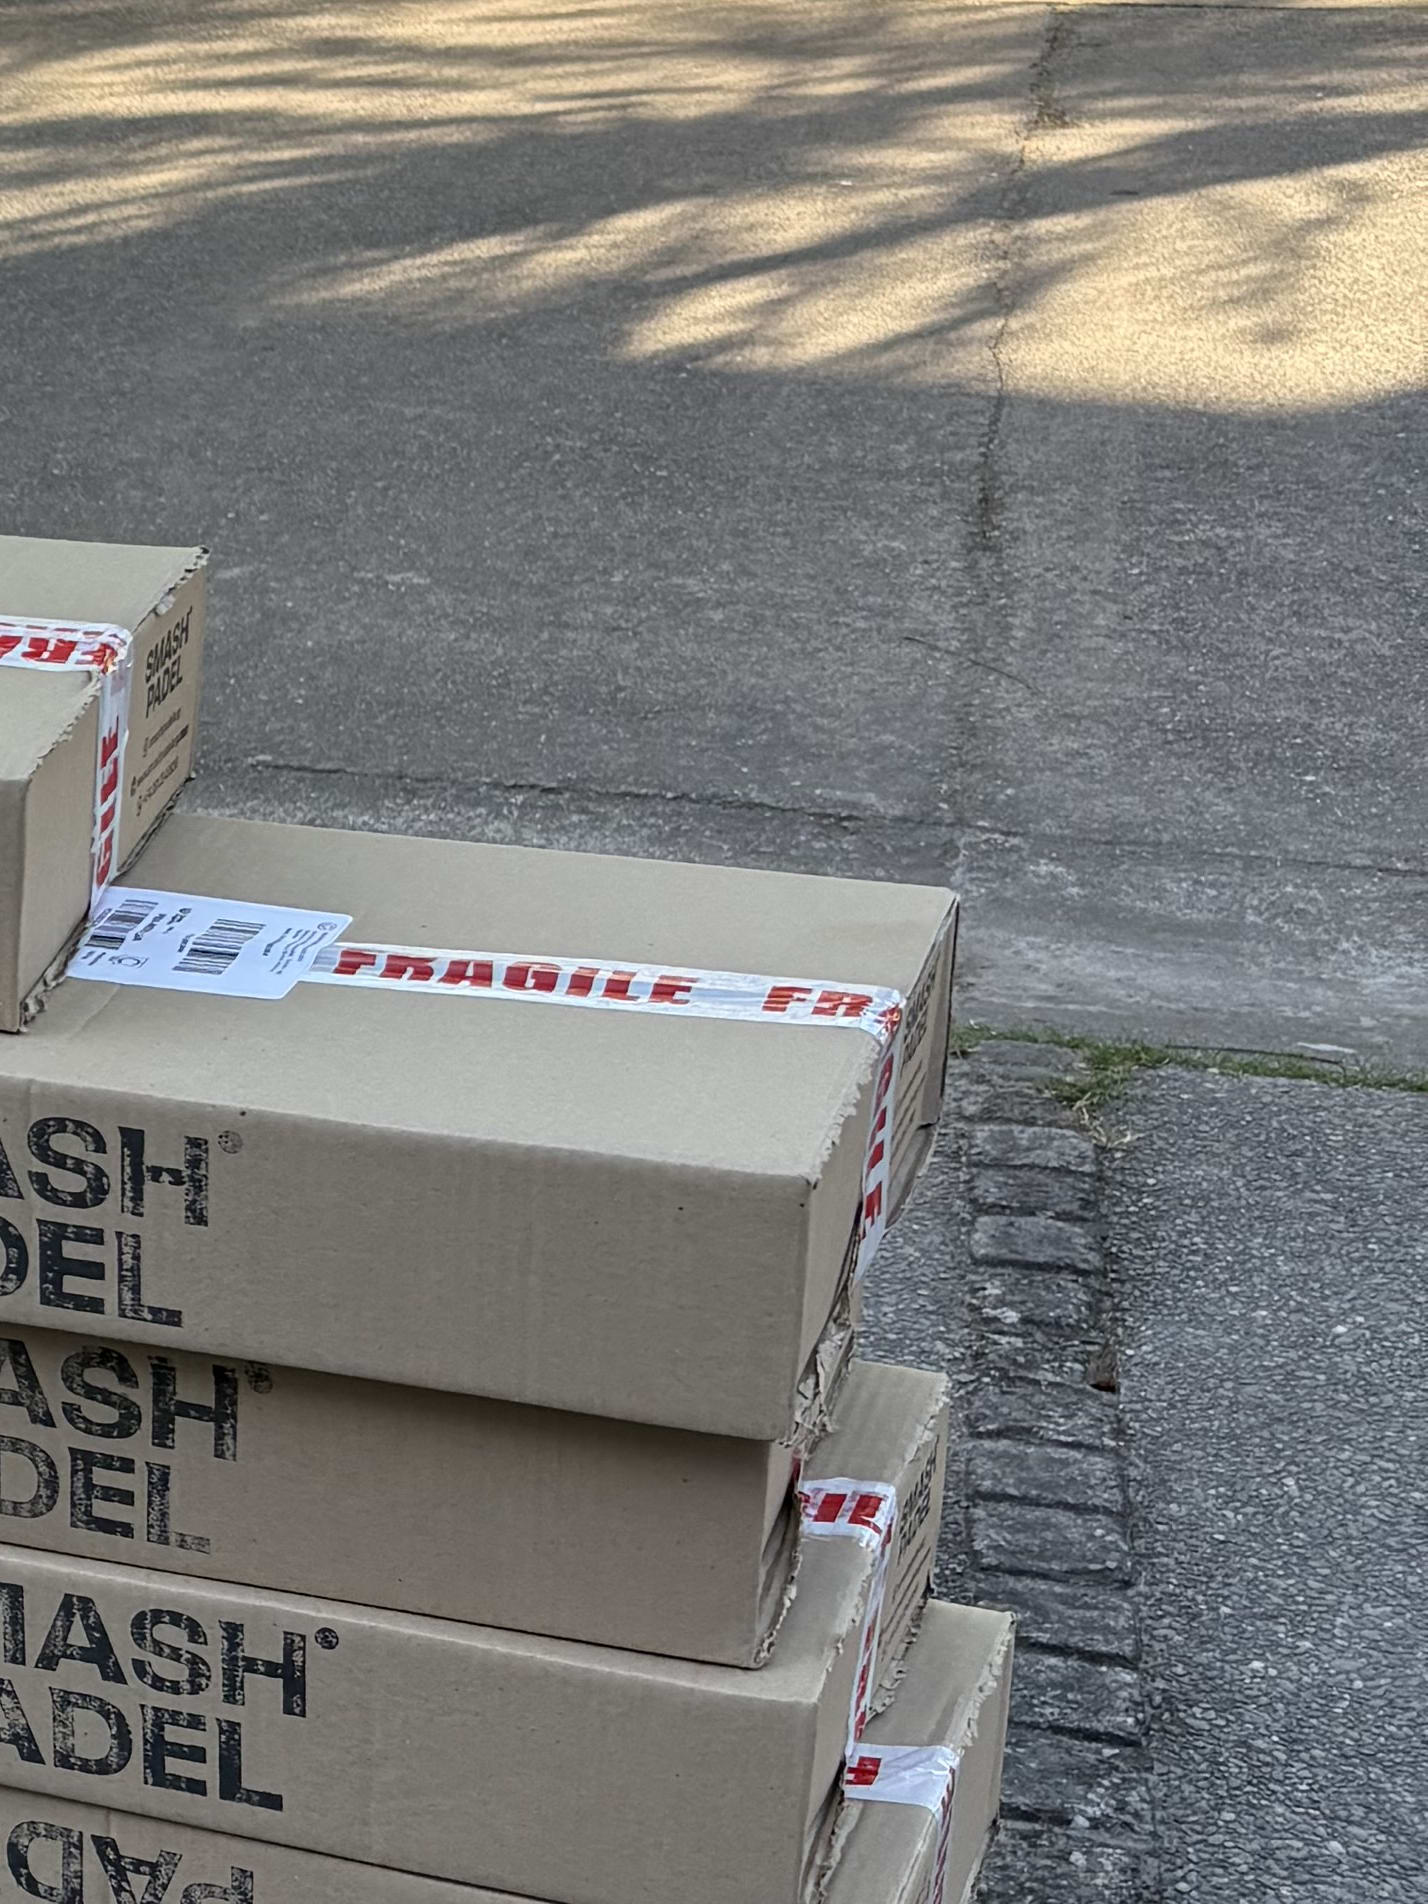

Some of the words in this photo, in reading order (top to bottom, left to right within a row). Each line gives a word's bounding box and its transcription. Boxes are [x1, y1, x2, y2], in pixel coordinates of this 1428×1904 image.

[145, 615, 191, 684] SMASH
[145, 654, 184, 719] PADEL
[333, 949, 700, 1007] FRAGILE
